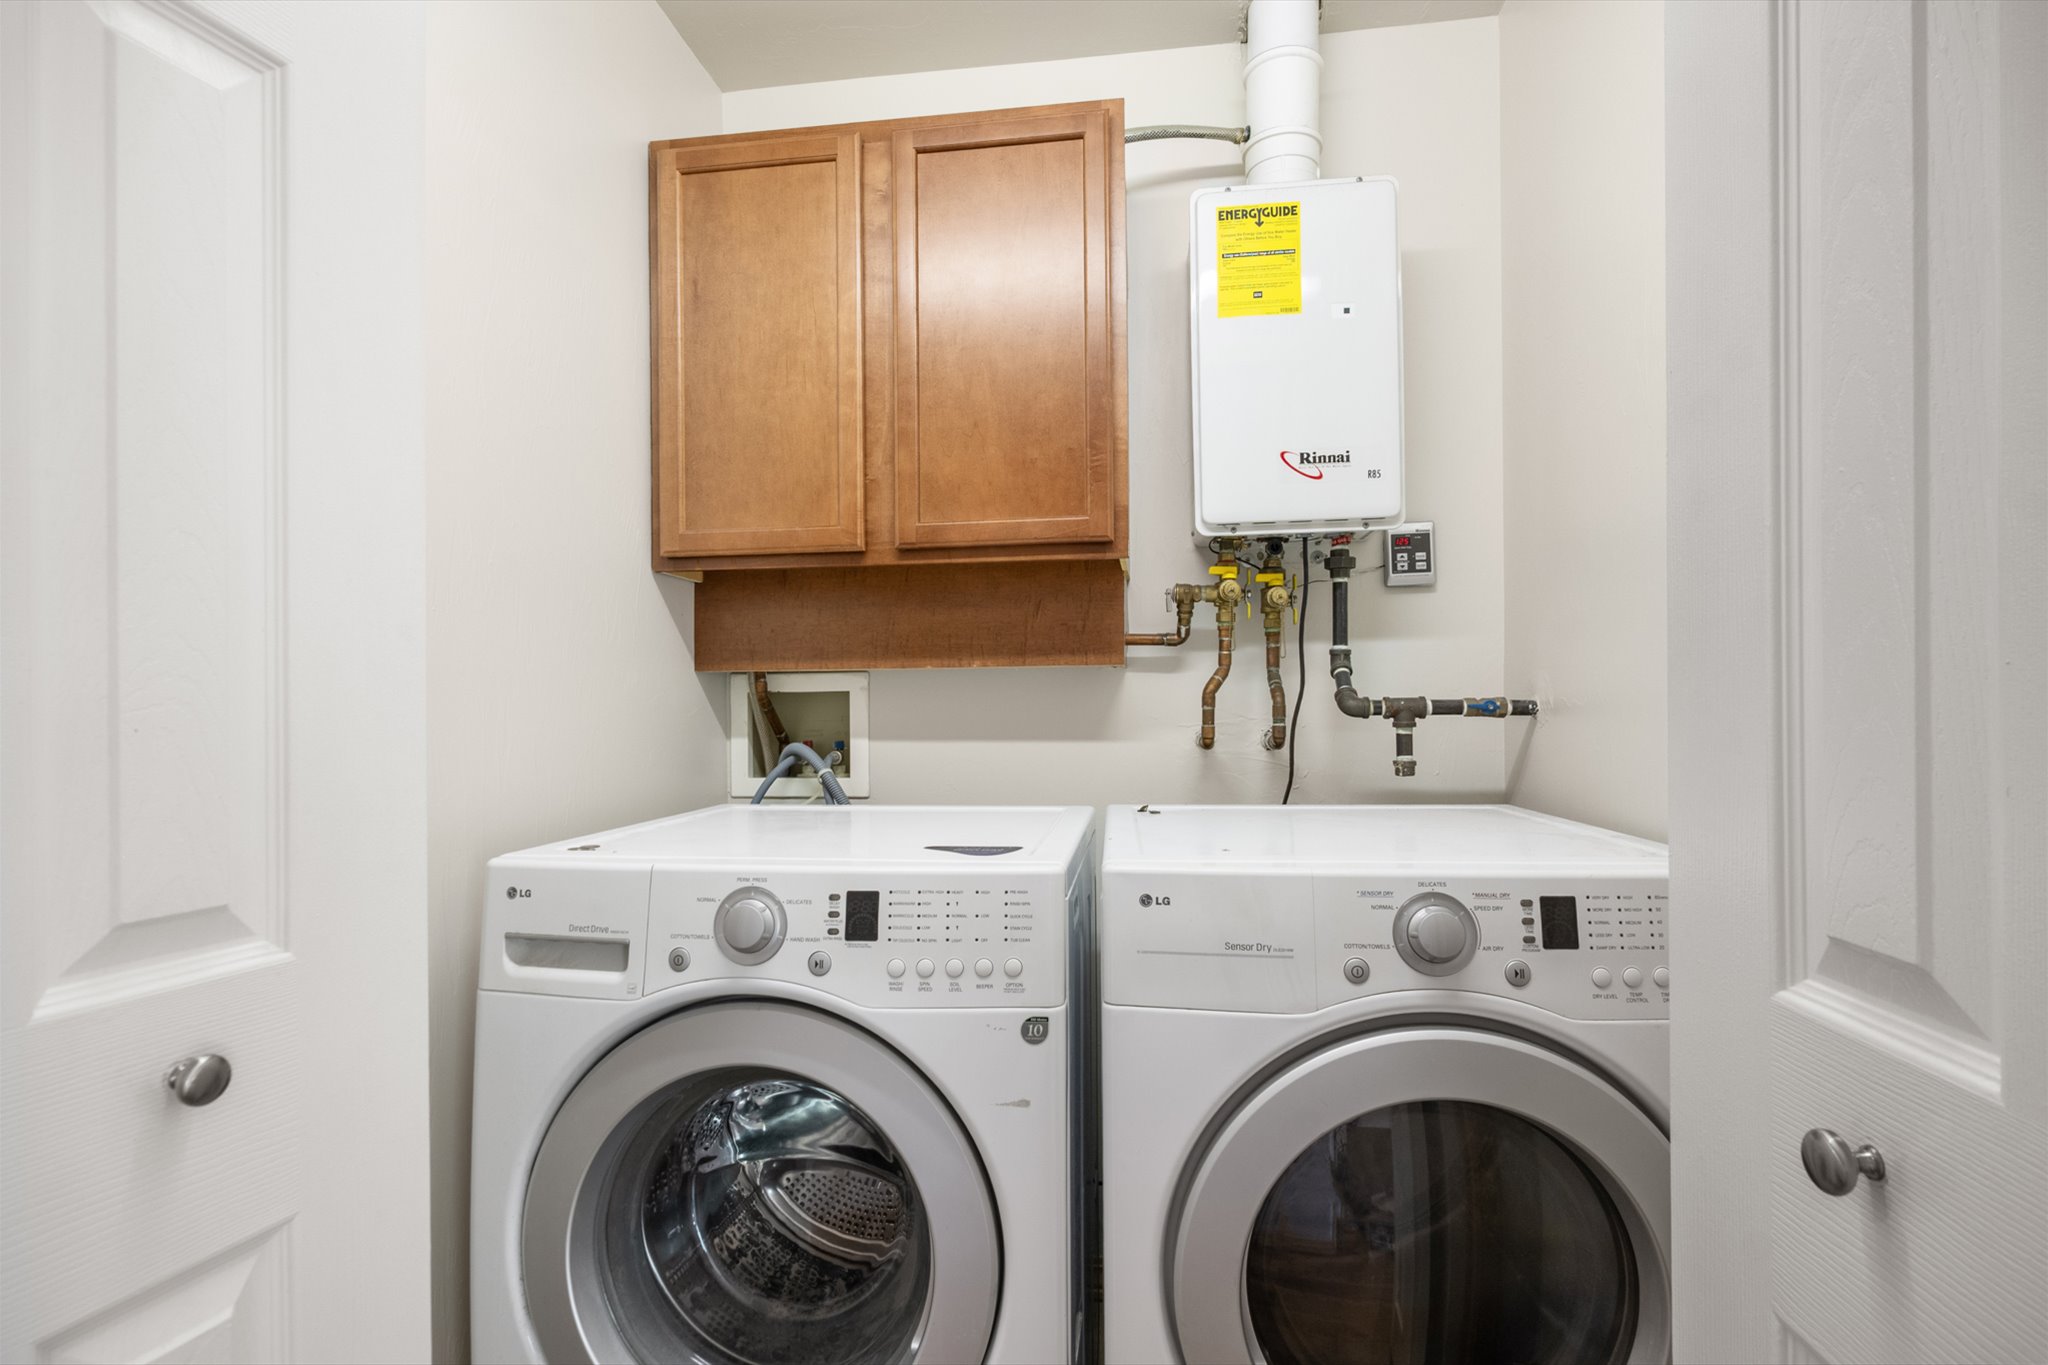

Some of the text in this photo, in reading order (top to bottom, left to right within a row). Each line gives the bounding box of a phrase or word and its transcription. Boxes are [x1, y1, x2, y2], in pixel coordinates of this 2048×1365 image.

[1218, 205, 1298, 223] ENERGYGUIDE
[1300, 451, 1350, 464] Rinnai
[1368, 470, 1381, 479] R85
[519, 889, 531, 898] LG
[1156, 897, 1170, 905] LG
[569, 924, 589, 933] Direct
[591, 925, 609, 934] Drive
[1225, 942, 1254, 951] Sensor
[1256, 943, 1272, 953] Dry
[1027, 1024, 1043, 1037] 10
